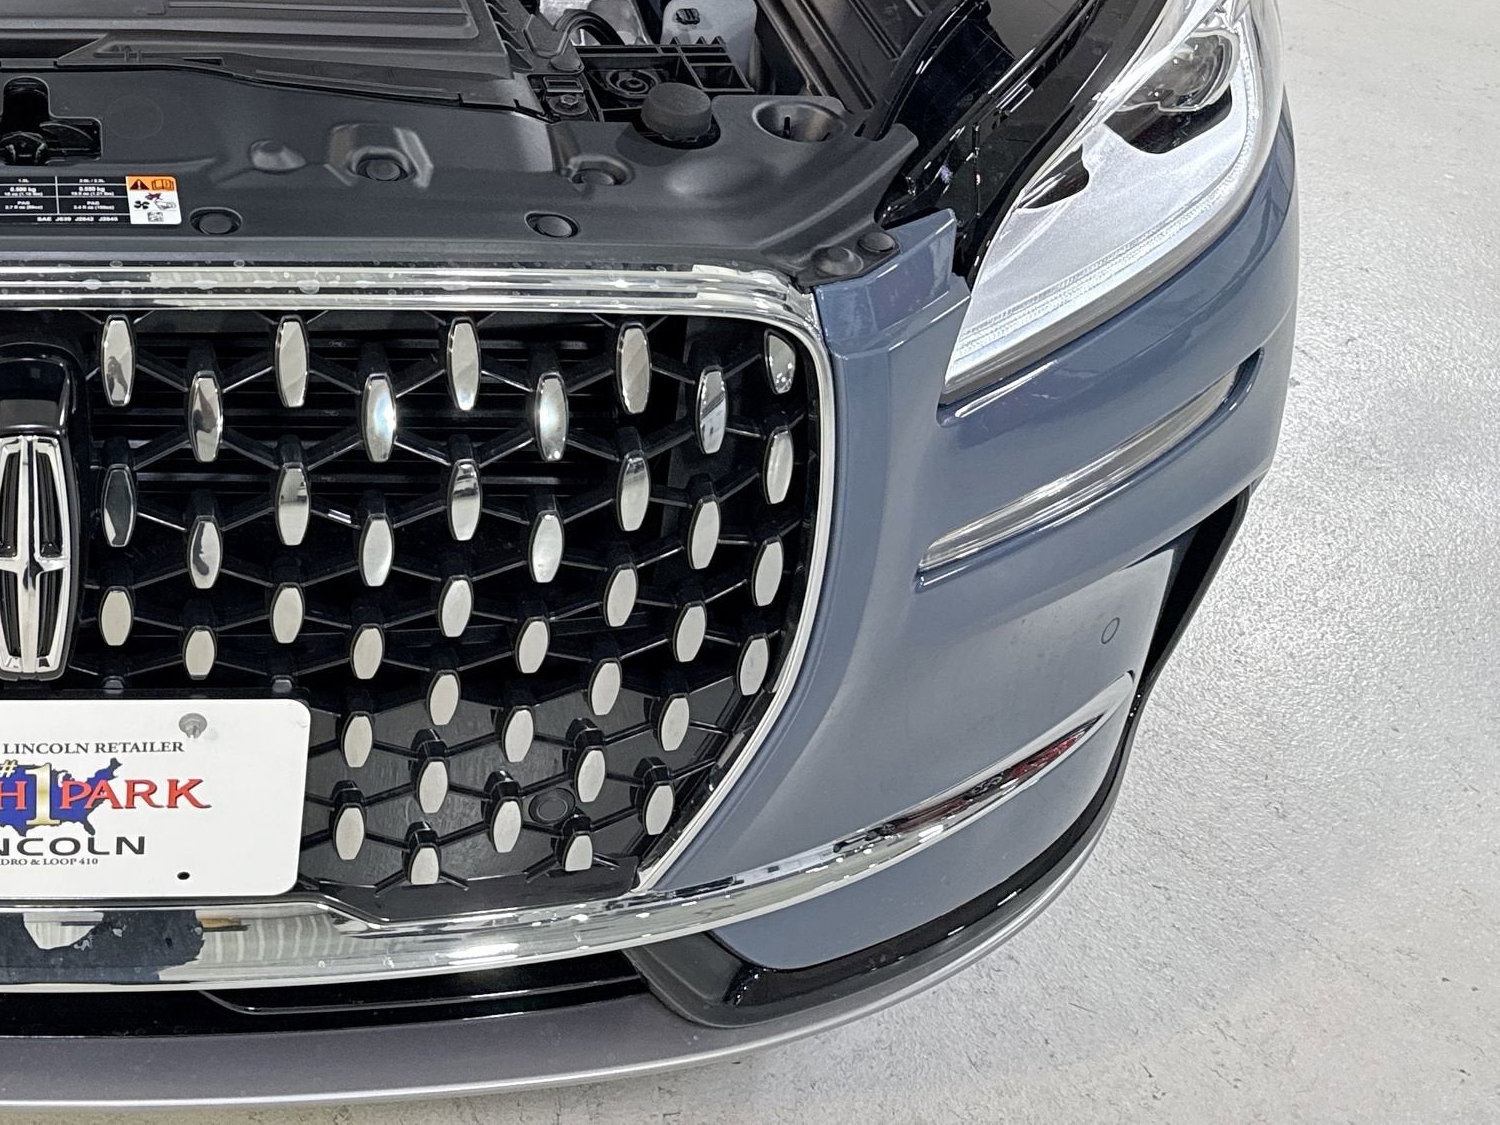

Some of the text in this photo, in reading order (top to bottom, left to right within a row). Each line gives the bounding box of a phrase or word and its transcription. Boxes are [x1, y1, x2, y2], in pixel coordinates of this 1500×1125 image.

[3, 742, 89, 755] LINCOLN
[94, 741, 185, 754] RETAILER
[59, 778, 212, 810] PARK
[30, 858, 41, 866] &
[43, 858, 77, 866] LOOP
[79, 857, 98, 865] 410
